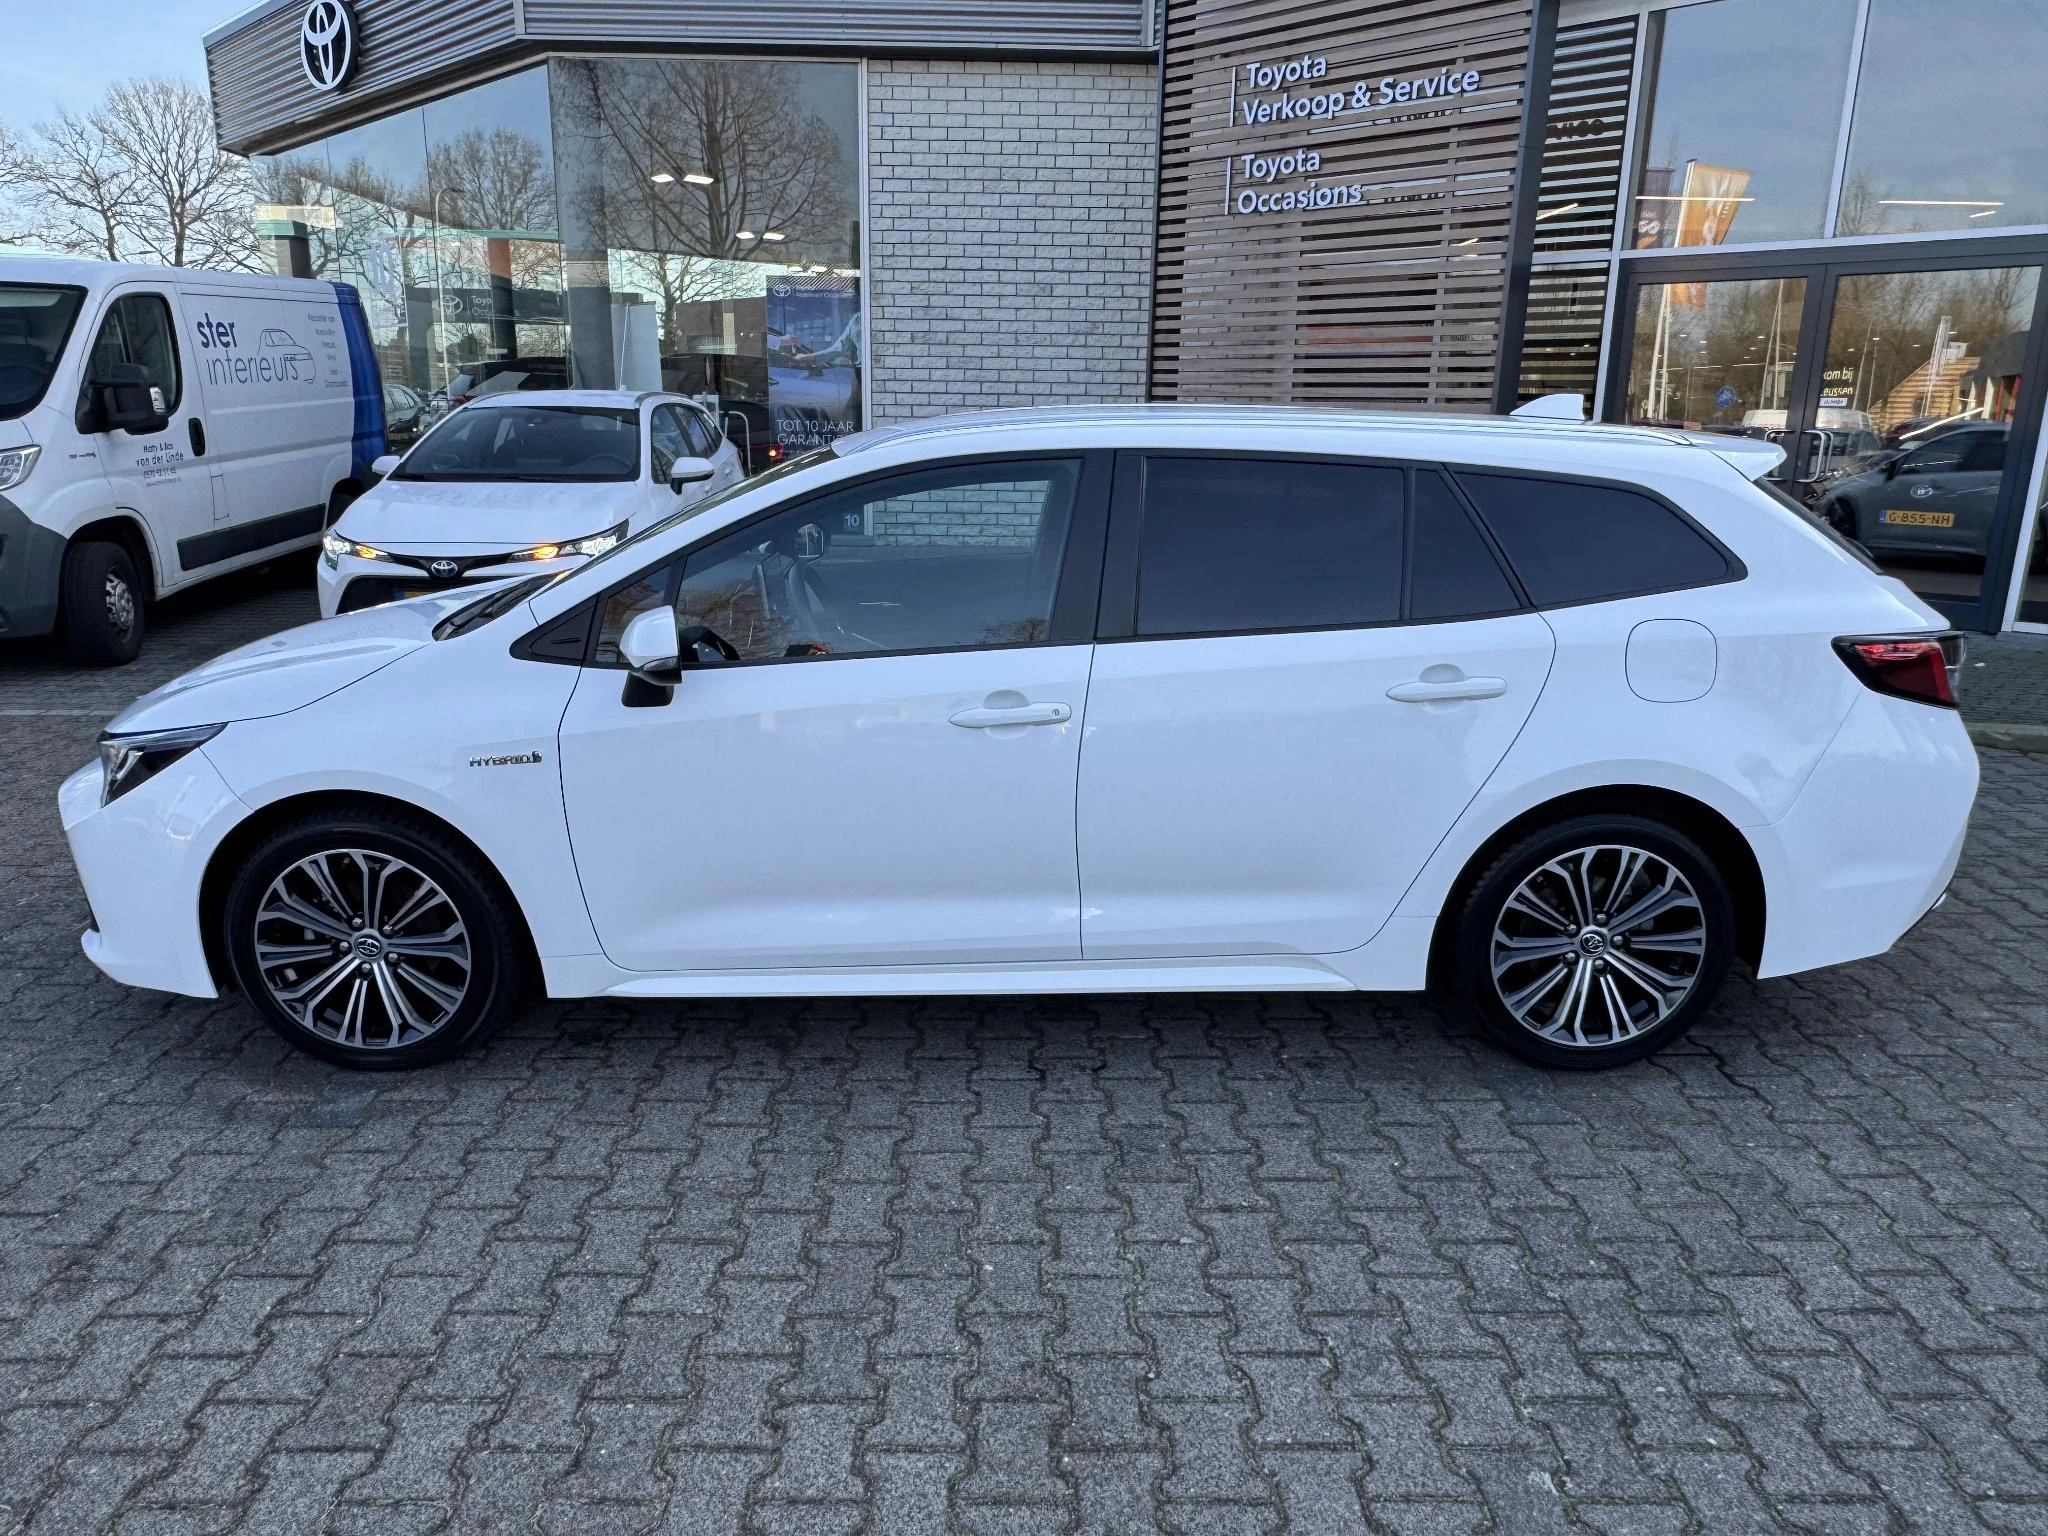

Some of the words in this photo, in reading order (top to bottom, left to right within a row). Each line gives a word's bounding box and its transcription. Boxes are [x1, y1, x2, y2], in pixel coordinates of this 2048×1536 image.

[1247, 54, 1328, 92] Toyota
[1243, 90, 1346, 127] Verkoop
[1351, 81, 1371, 110] &
[1379, 67, 1481, 104] Service
[1241, 149, 1321, 183] Toyota
[1237, 182, 1363, 215] Occasions
[196, 312, 239, 349] ster
[206, 349, 299, 386] interieurs
[1820, 387, 1853, 397] eussen
[775, 419, 801, 432] TOT
[804, 420, 819, 432] 10
[822, 420, 855, 433] JAAR
[151, 455, 164, 465] der
[165, 450, 184, 463] Linde
[843, 513, 860, 527] 10
[1888, 511, 1950, 525] G-855-NH
[469, 754, 530, 767] HYBRID
